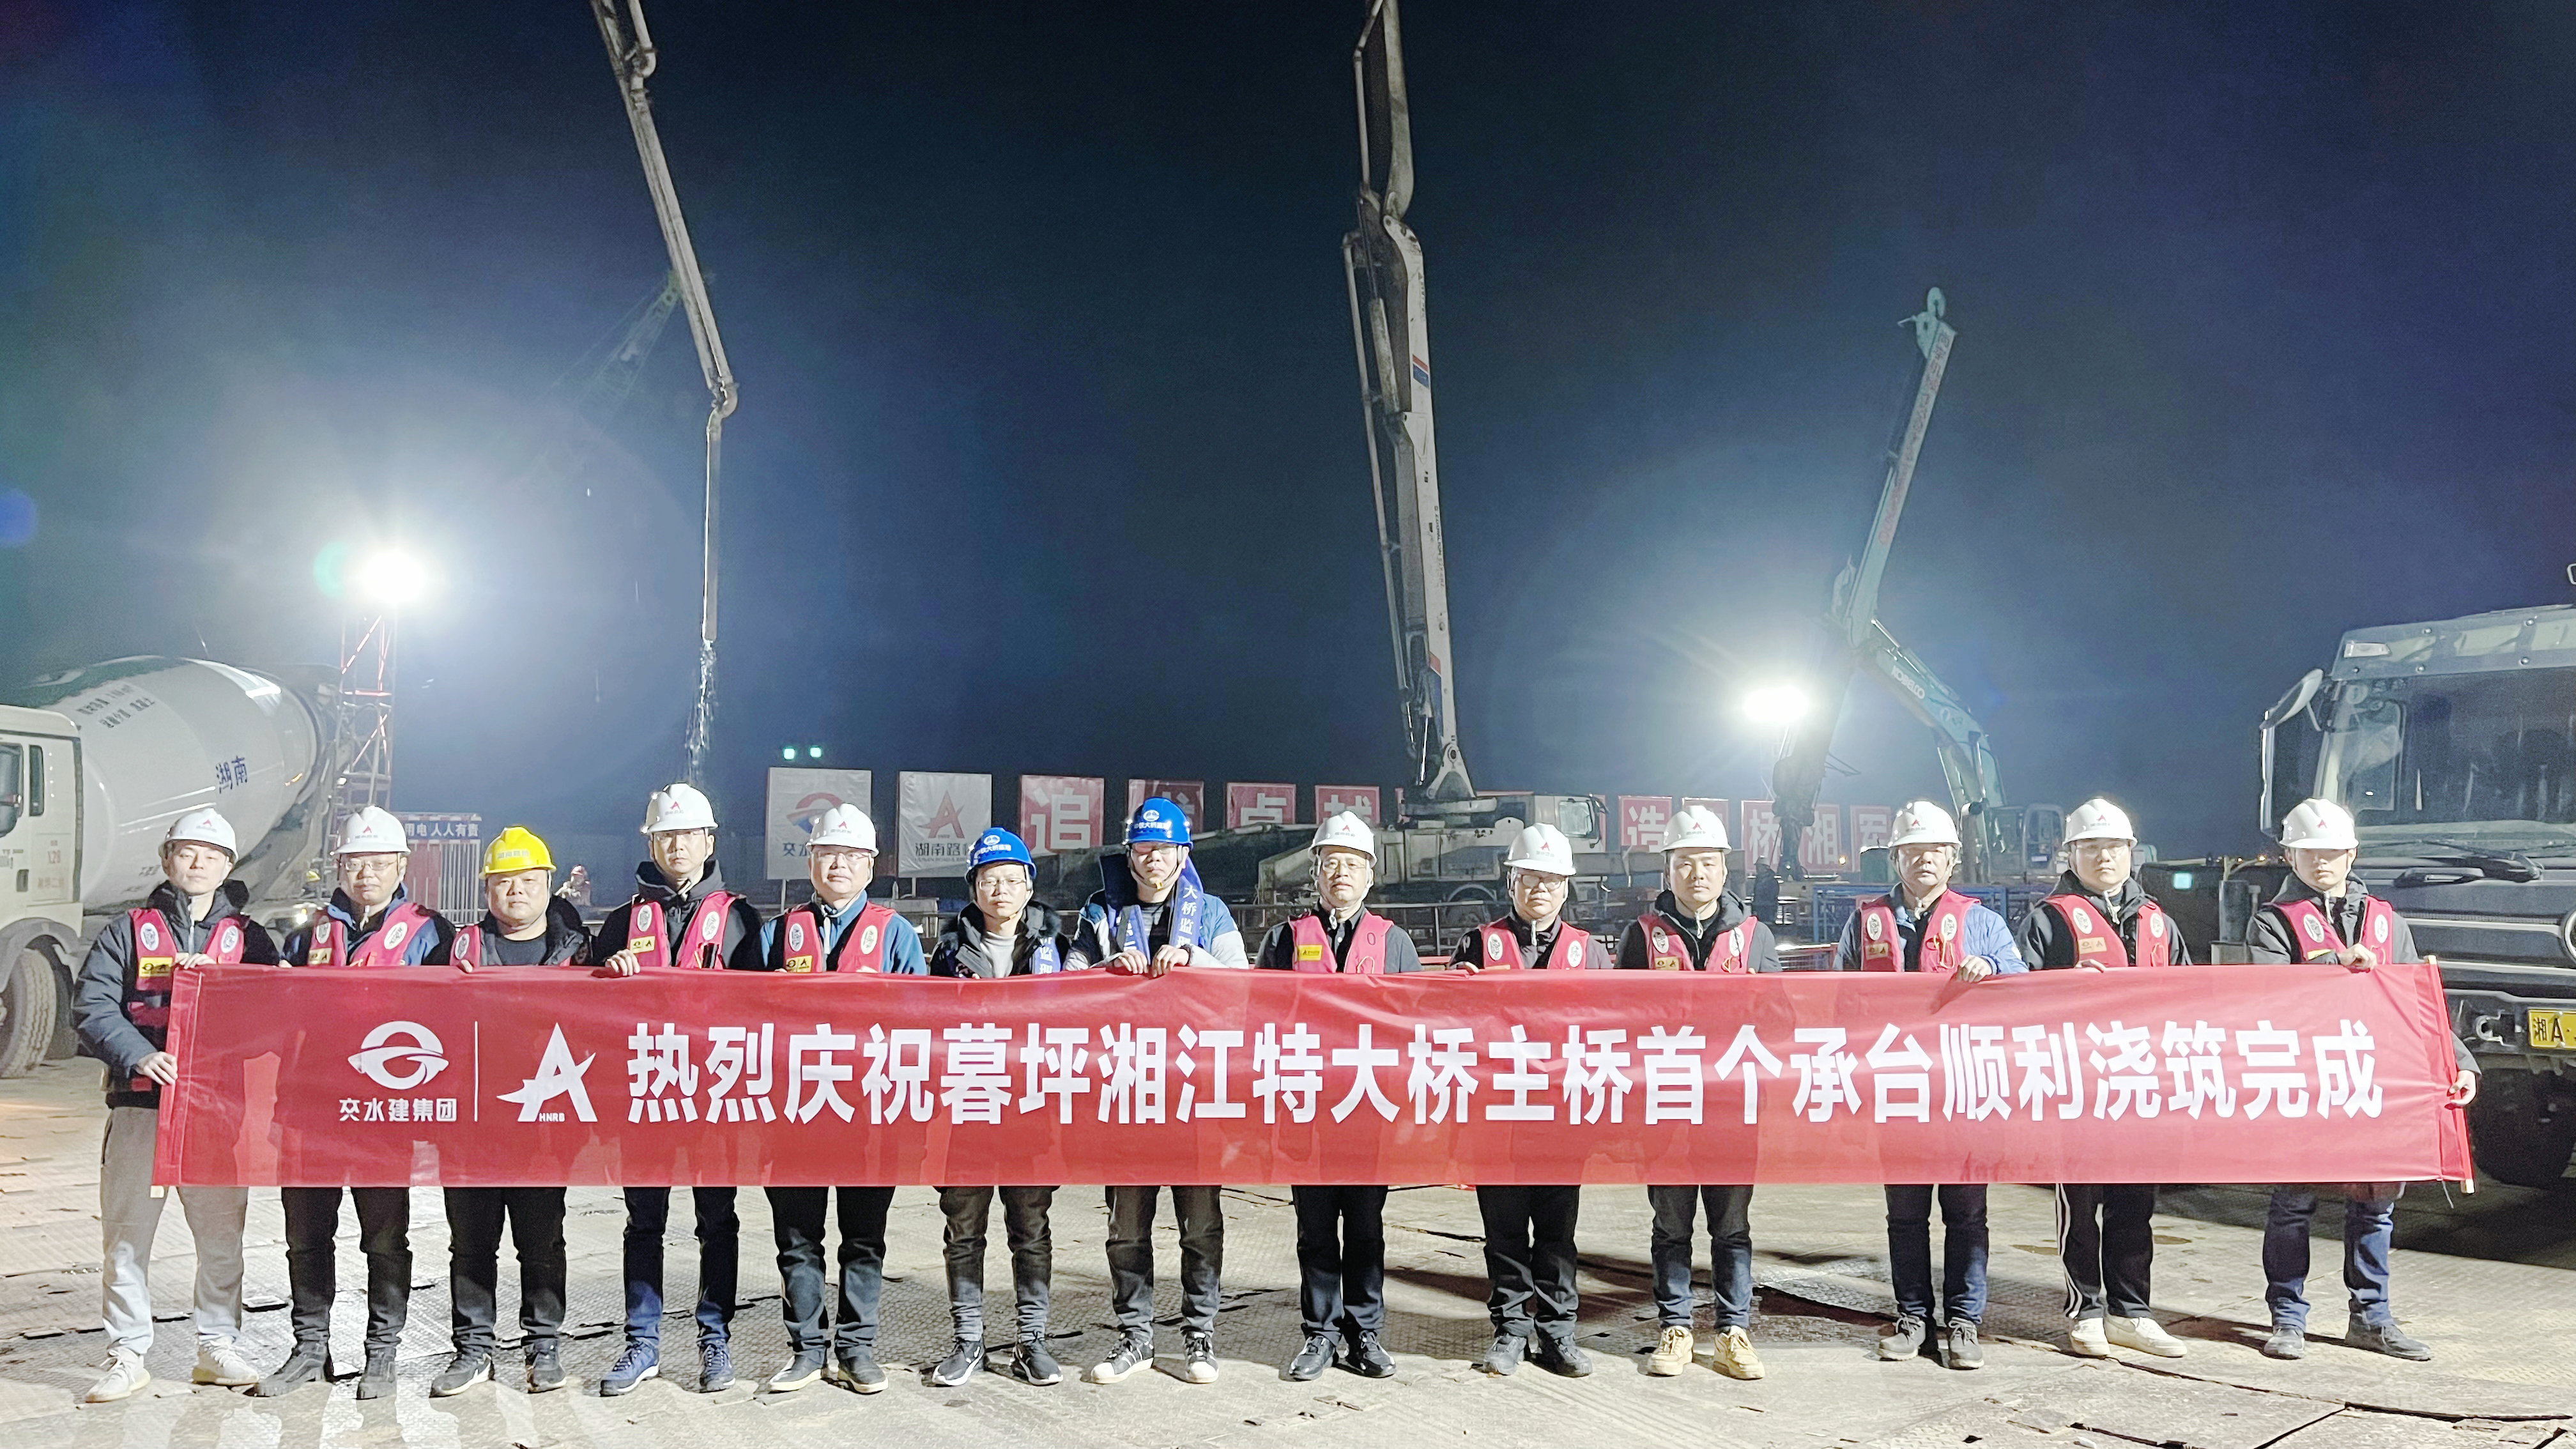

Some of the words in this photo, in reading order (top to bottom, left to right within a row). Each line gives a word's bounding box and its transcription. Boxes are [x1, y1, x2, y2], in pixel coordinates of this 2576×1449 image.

[1891, 665, 1926, 699] KOBELCO
[215, 755, 248, 793] 湖南
[1029, 787, 1091, 855] 追
[1807, 809, 1834, 865] 湘
[628, 1020, 2382, 1123] 热烈庆祝暮坪湘江特大桥主桥首个承台顺利浇筑完成
[339, 1098, 457, 1122] 交水建集团
[539, 1112, 565, 1122] HNRB
